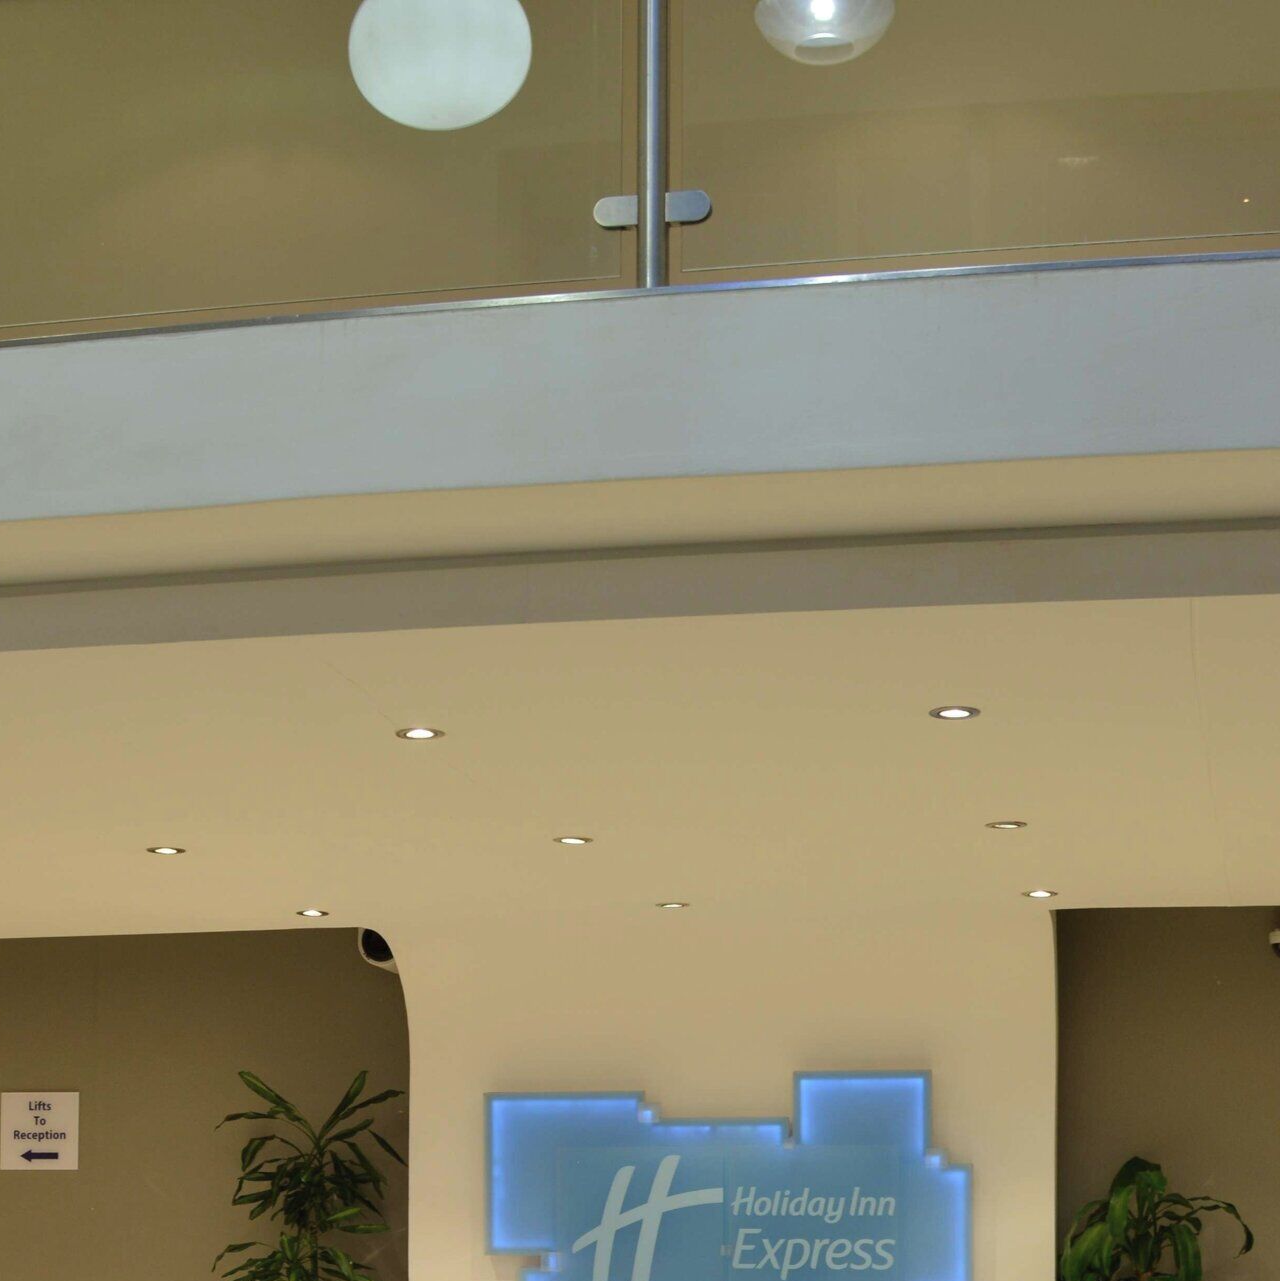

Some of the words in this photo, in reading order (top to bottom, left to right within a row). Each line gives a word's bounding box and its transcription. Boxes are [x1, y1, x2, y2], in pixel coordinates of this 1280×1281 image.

[28, 1101, 52, 1111] Lifts
[33, 1116, 46, 1126] To
[13, 1130, 66, 1142] Reception
[731, 1186, 845, 1224] Holiday
[849, 1186, 896, 1216] Inn
[732, 1228, 896, 1281] Express
